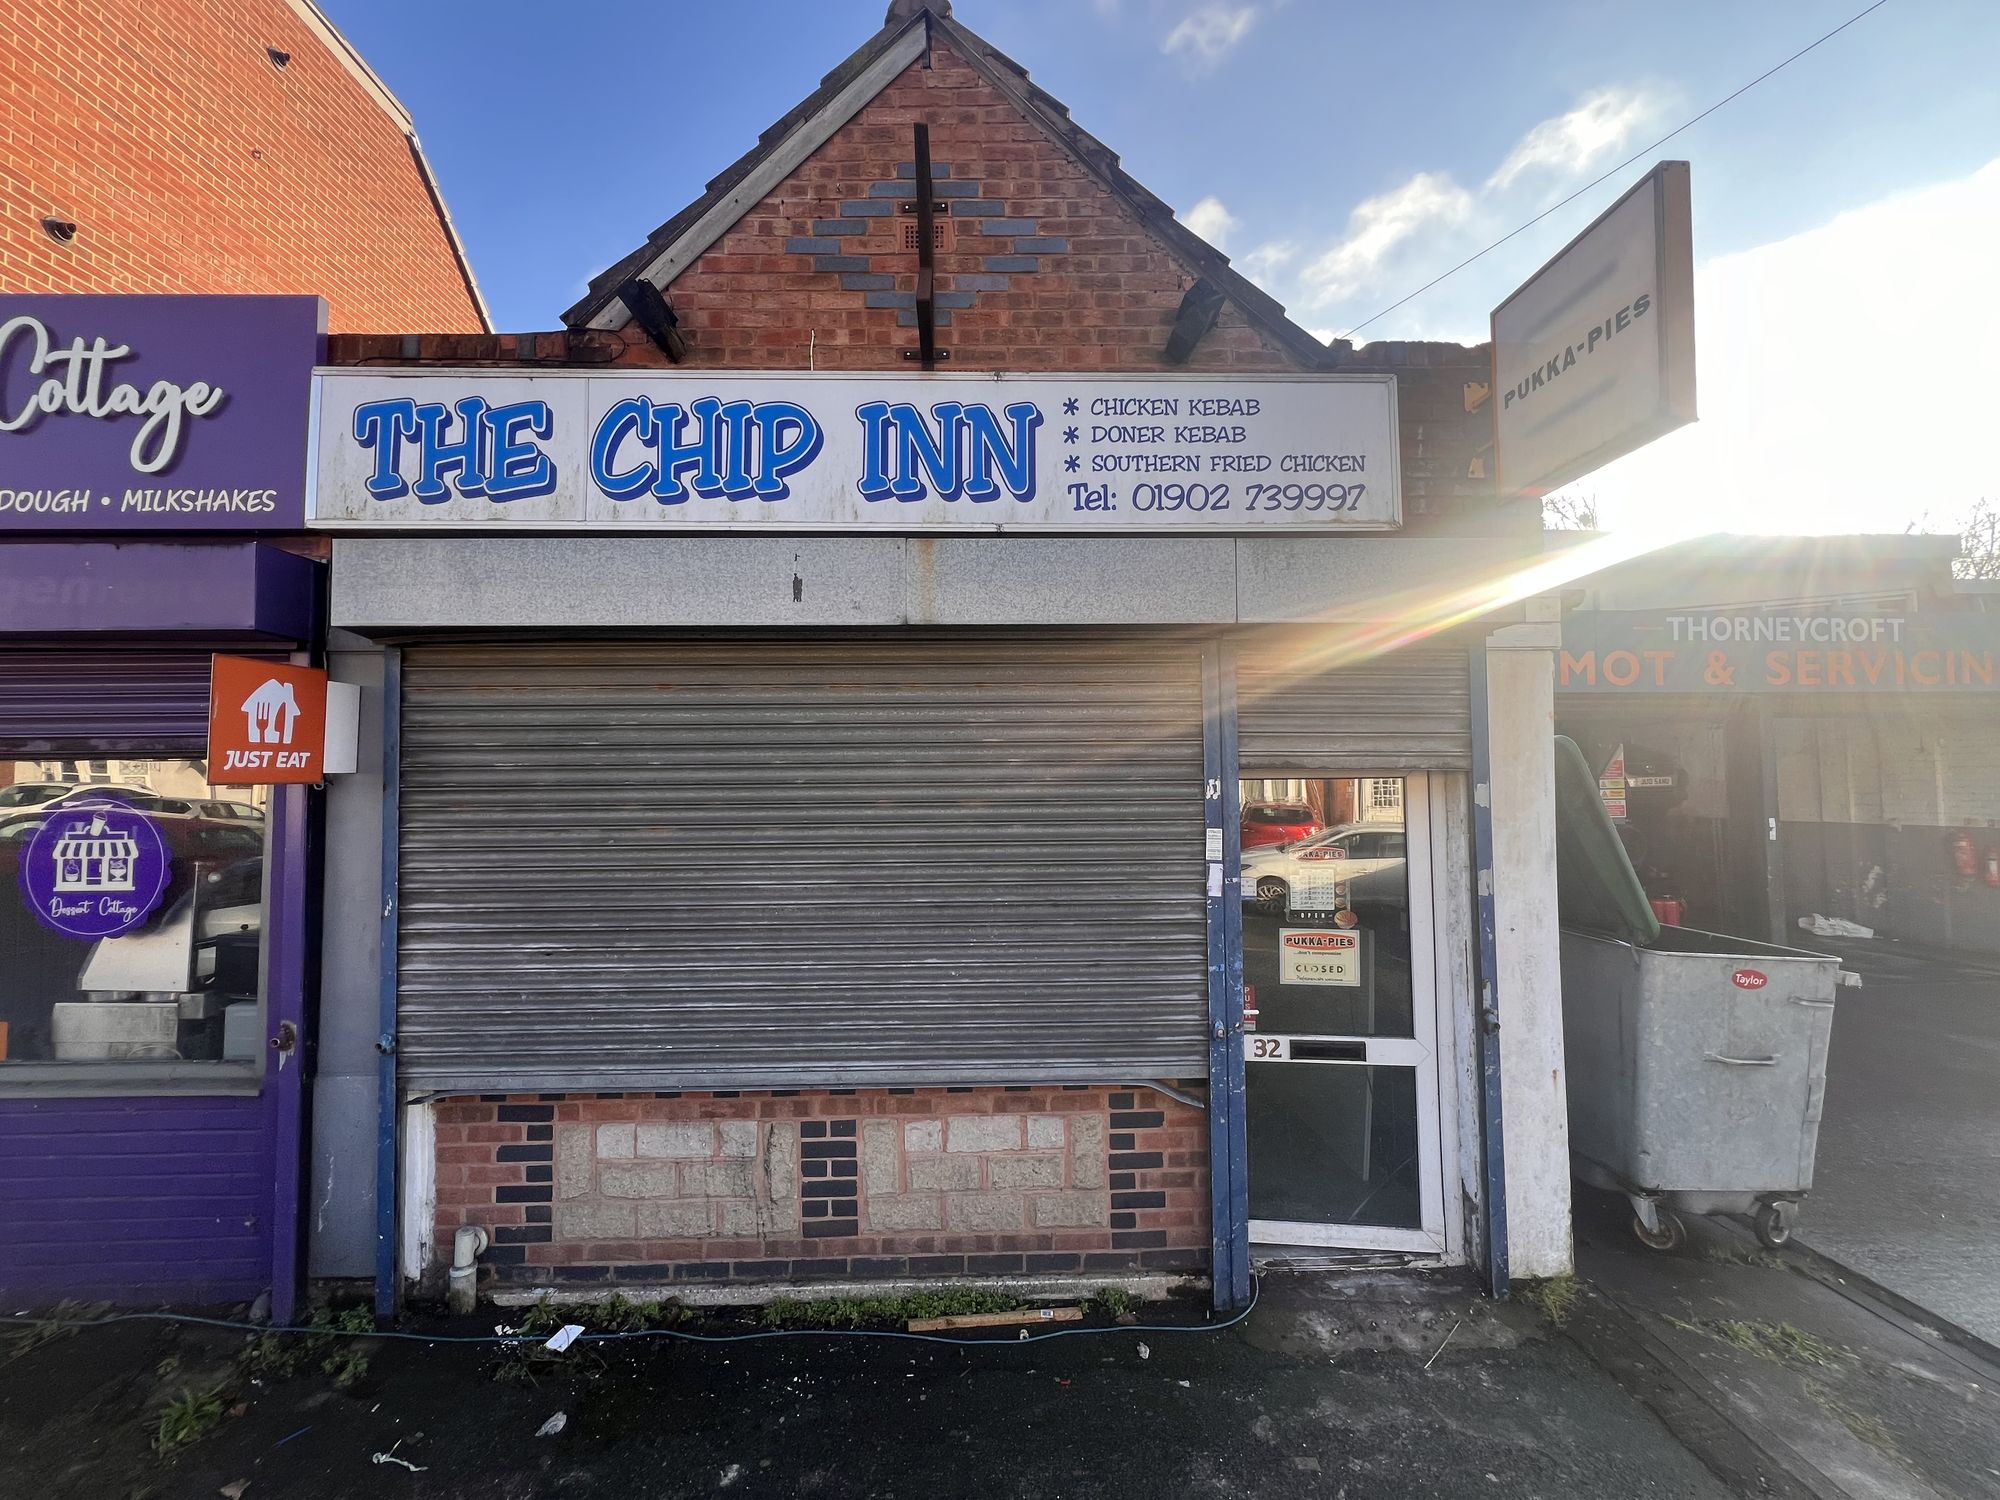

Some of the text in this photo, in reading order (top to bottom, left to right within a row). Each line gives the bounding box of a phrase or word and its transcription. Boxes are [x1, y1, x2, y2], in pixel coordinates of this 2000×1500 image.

[1504, 294, 1650, 410] PUKKA-PIES
[0, 316, 223, 473] Cottage
[1090, 398, 1261, 416] CHICKEN KEBAB
[1091, 426, 1247, 443] DONER KEBAB
[352, 394, 1044, 505] THE CHIP INN
[1092, 455, 1367, 473] SOUTHERN FRIED CHICKEN
[120, 489, 277, 512] MILKSHAKES
[1067, 482, 1367, 511] Tel: 01902 739997
[1666, 616, 1905, 643] THORNEYCROFT
[1560, 650, 1994, 687] MOT & SERVICIN
[223, 750, 311, 771] JUST EAT
[99, 896, 138, 923] Cottage
[1286, 937, 1354, 946] PUKKA-PIES
[1295, 964, 1344, 974] CLOSED
[1735, 973, 1764, 986] Taylor
[1253, 1038, 1282, 1058] 32
